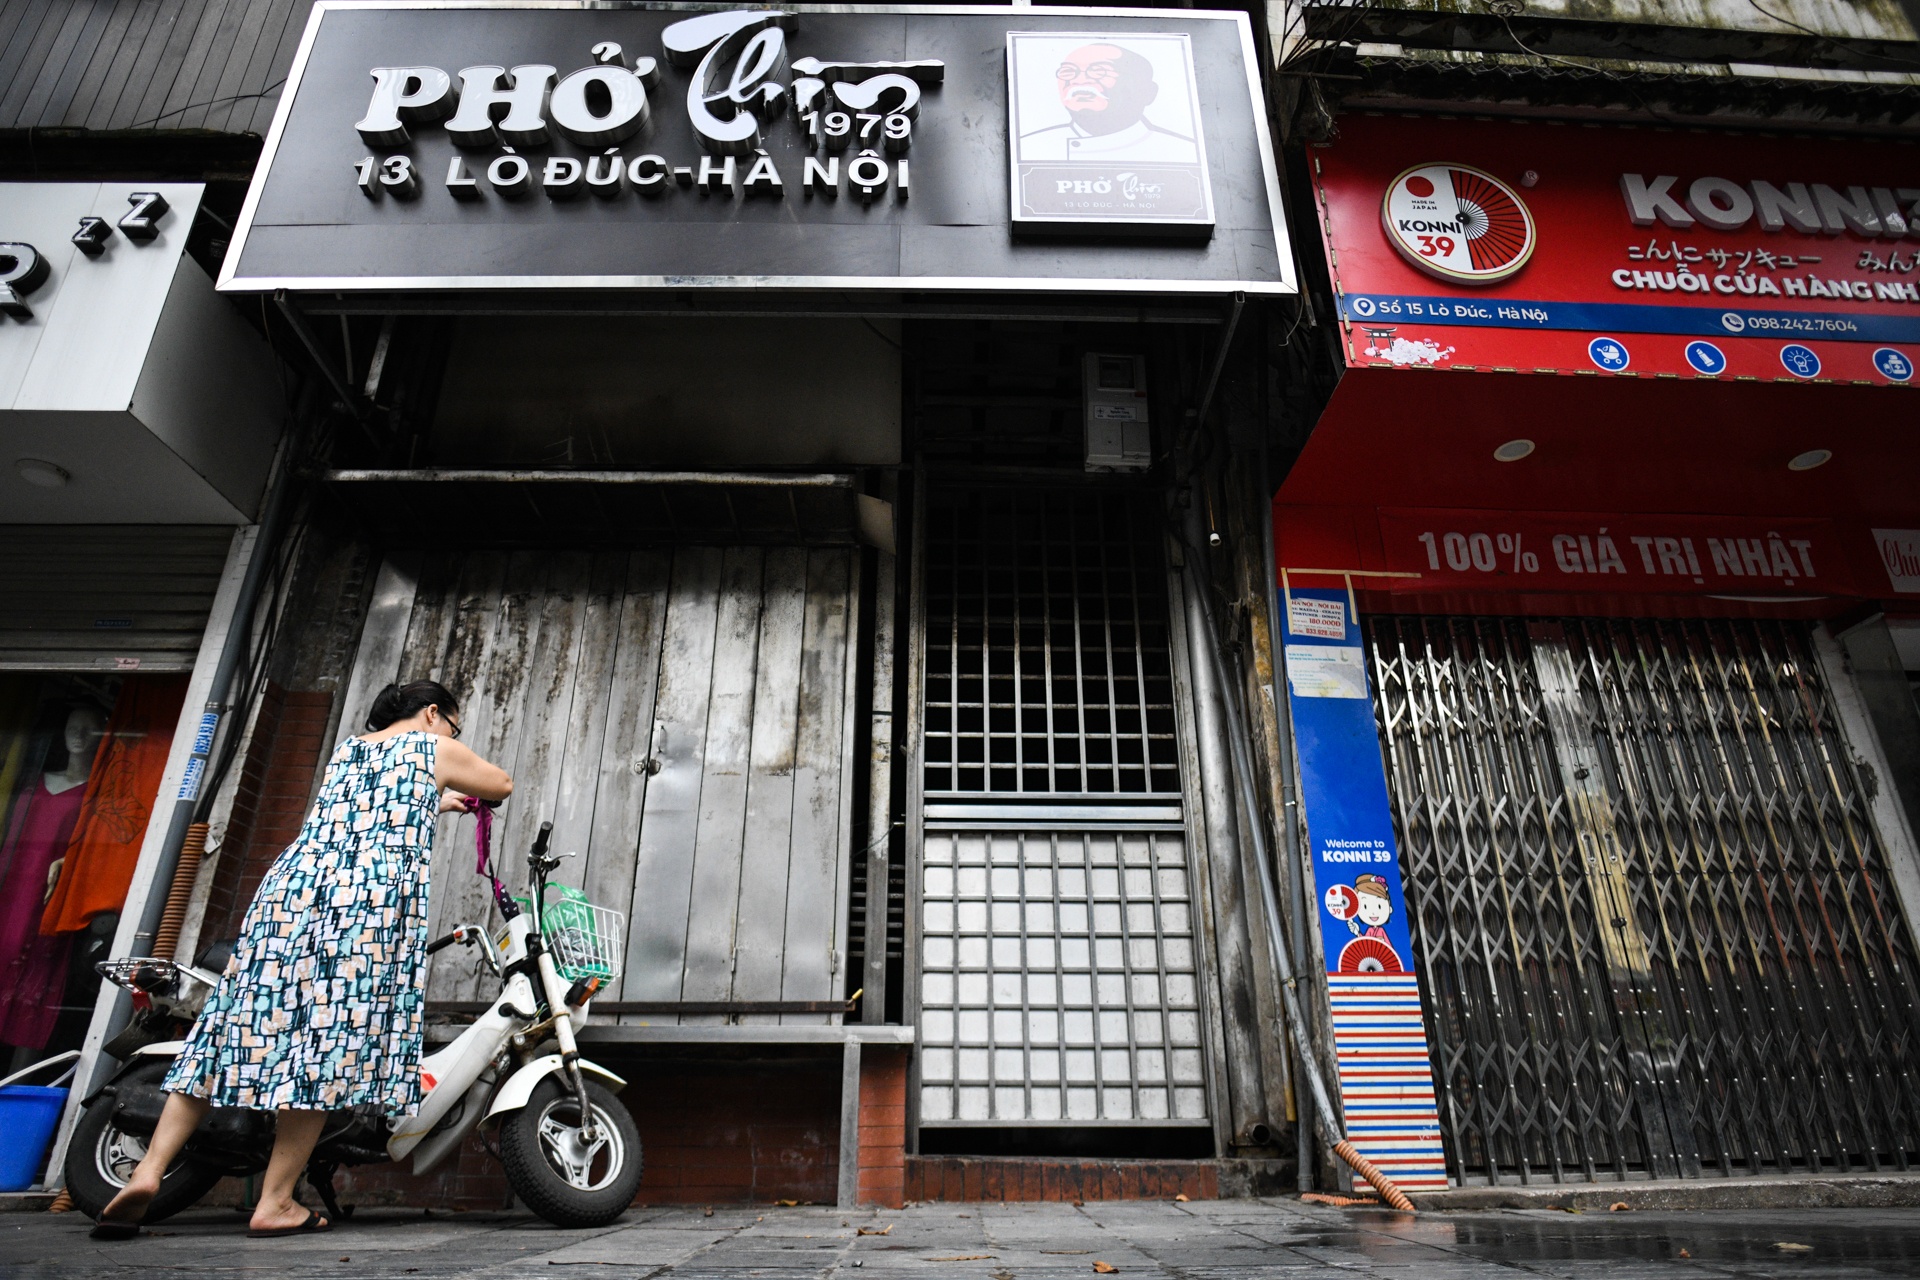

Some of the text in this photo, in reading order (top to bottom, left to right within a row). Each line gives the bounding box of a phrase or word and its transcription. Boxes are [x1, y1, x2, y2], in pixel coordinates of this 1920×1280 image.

[355, 41, 659, 142] PHỞ
[801, 110, 911, 142] 1979
[354, 156, 411, 188] 13
[445, 146, 529, 188] LÒ
[803, 148, 909, 195] NỘI
[1056, 176, 1112, 194] PHỞ
[1399, 219, 1462, 234] KONNI
[1416, 235, 1455, 257] 39
[1611, 263, 1920, 301] CHUỖI CỬA HÀNG NH
[1379, 300, 1549, 325] Số 15 Lò Đúc, Hà Nội
[1747, 316, 1858, 333] 098.242.7604
[1417, 527, 1817, 587] 100% GIÁ TRỊ NHẬT
[1325, 839, 1385, 848] Welcome to
[1322, 850, 1391, 863] KONNI 39
